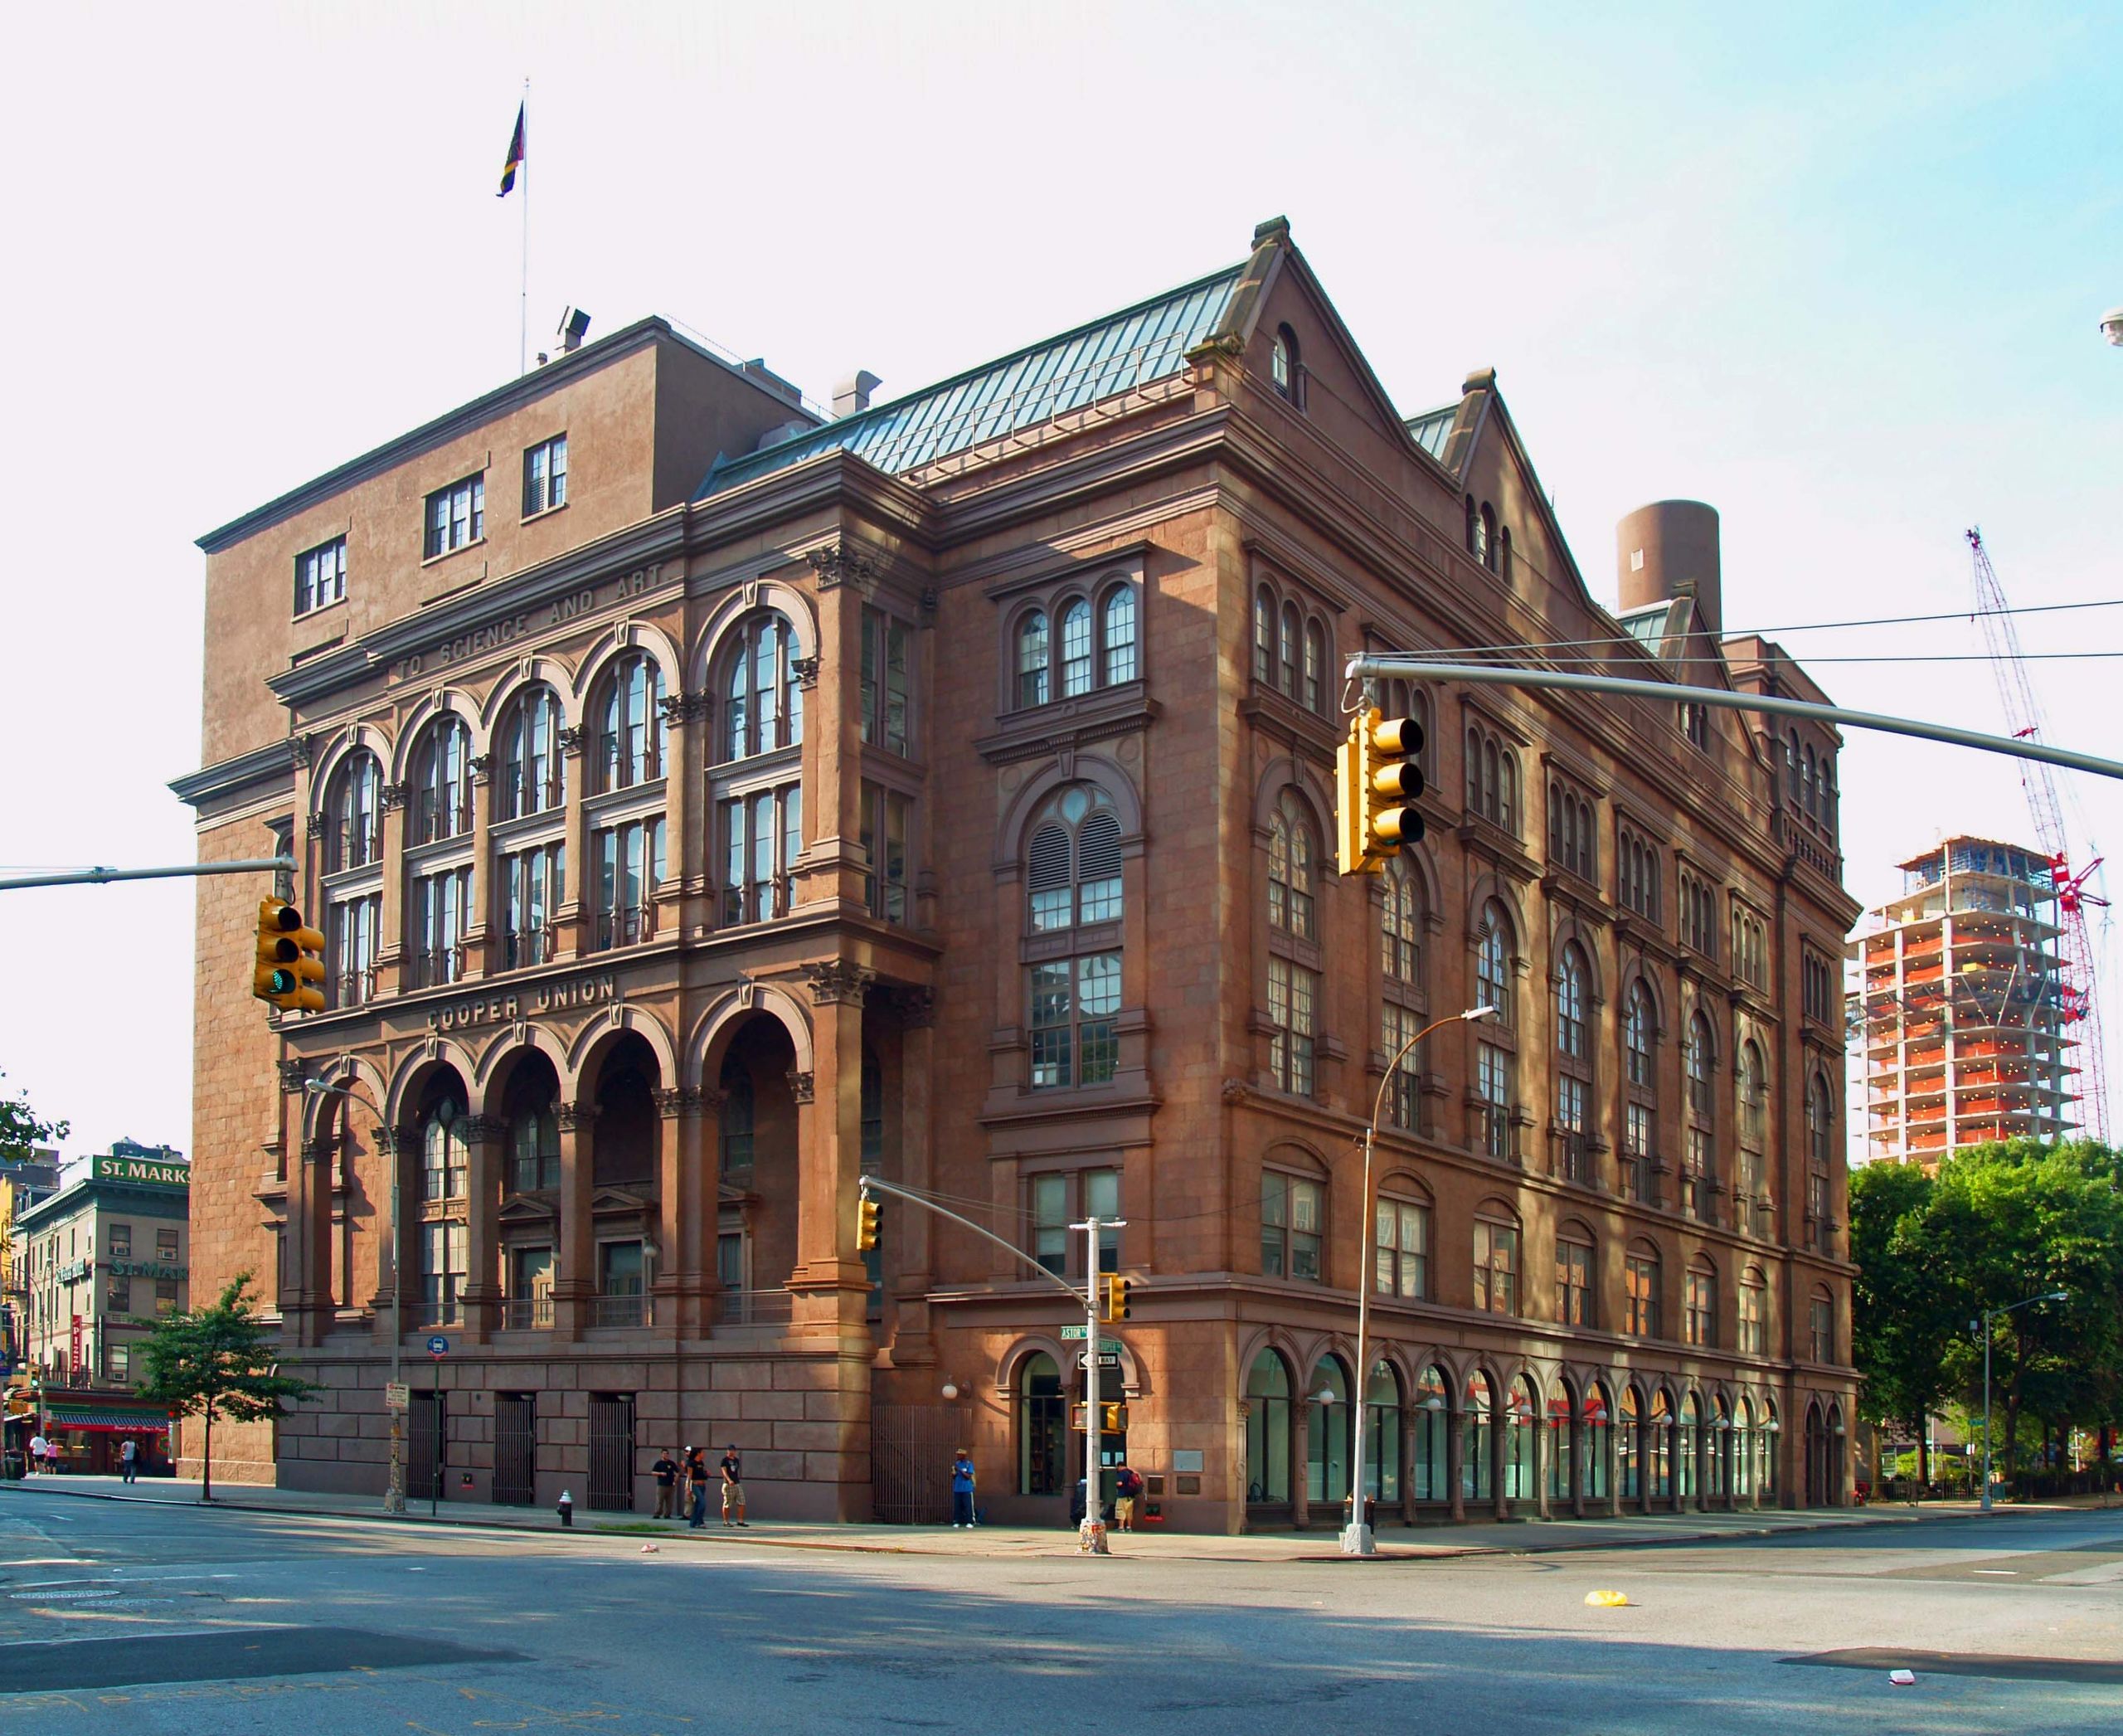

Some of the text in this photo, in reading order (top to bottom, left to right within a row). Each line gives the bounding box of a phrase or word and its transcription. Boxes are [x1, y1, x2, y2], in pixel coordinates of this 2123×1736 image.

[396, 563, 663, 680] TO SCIENCE AND ART
[427, 975, 615, 1030] COOPER UNION
[101, 1160, 124, 1176] ST.
[1062, 1328, 1081, 1338] ASTOR
